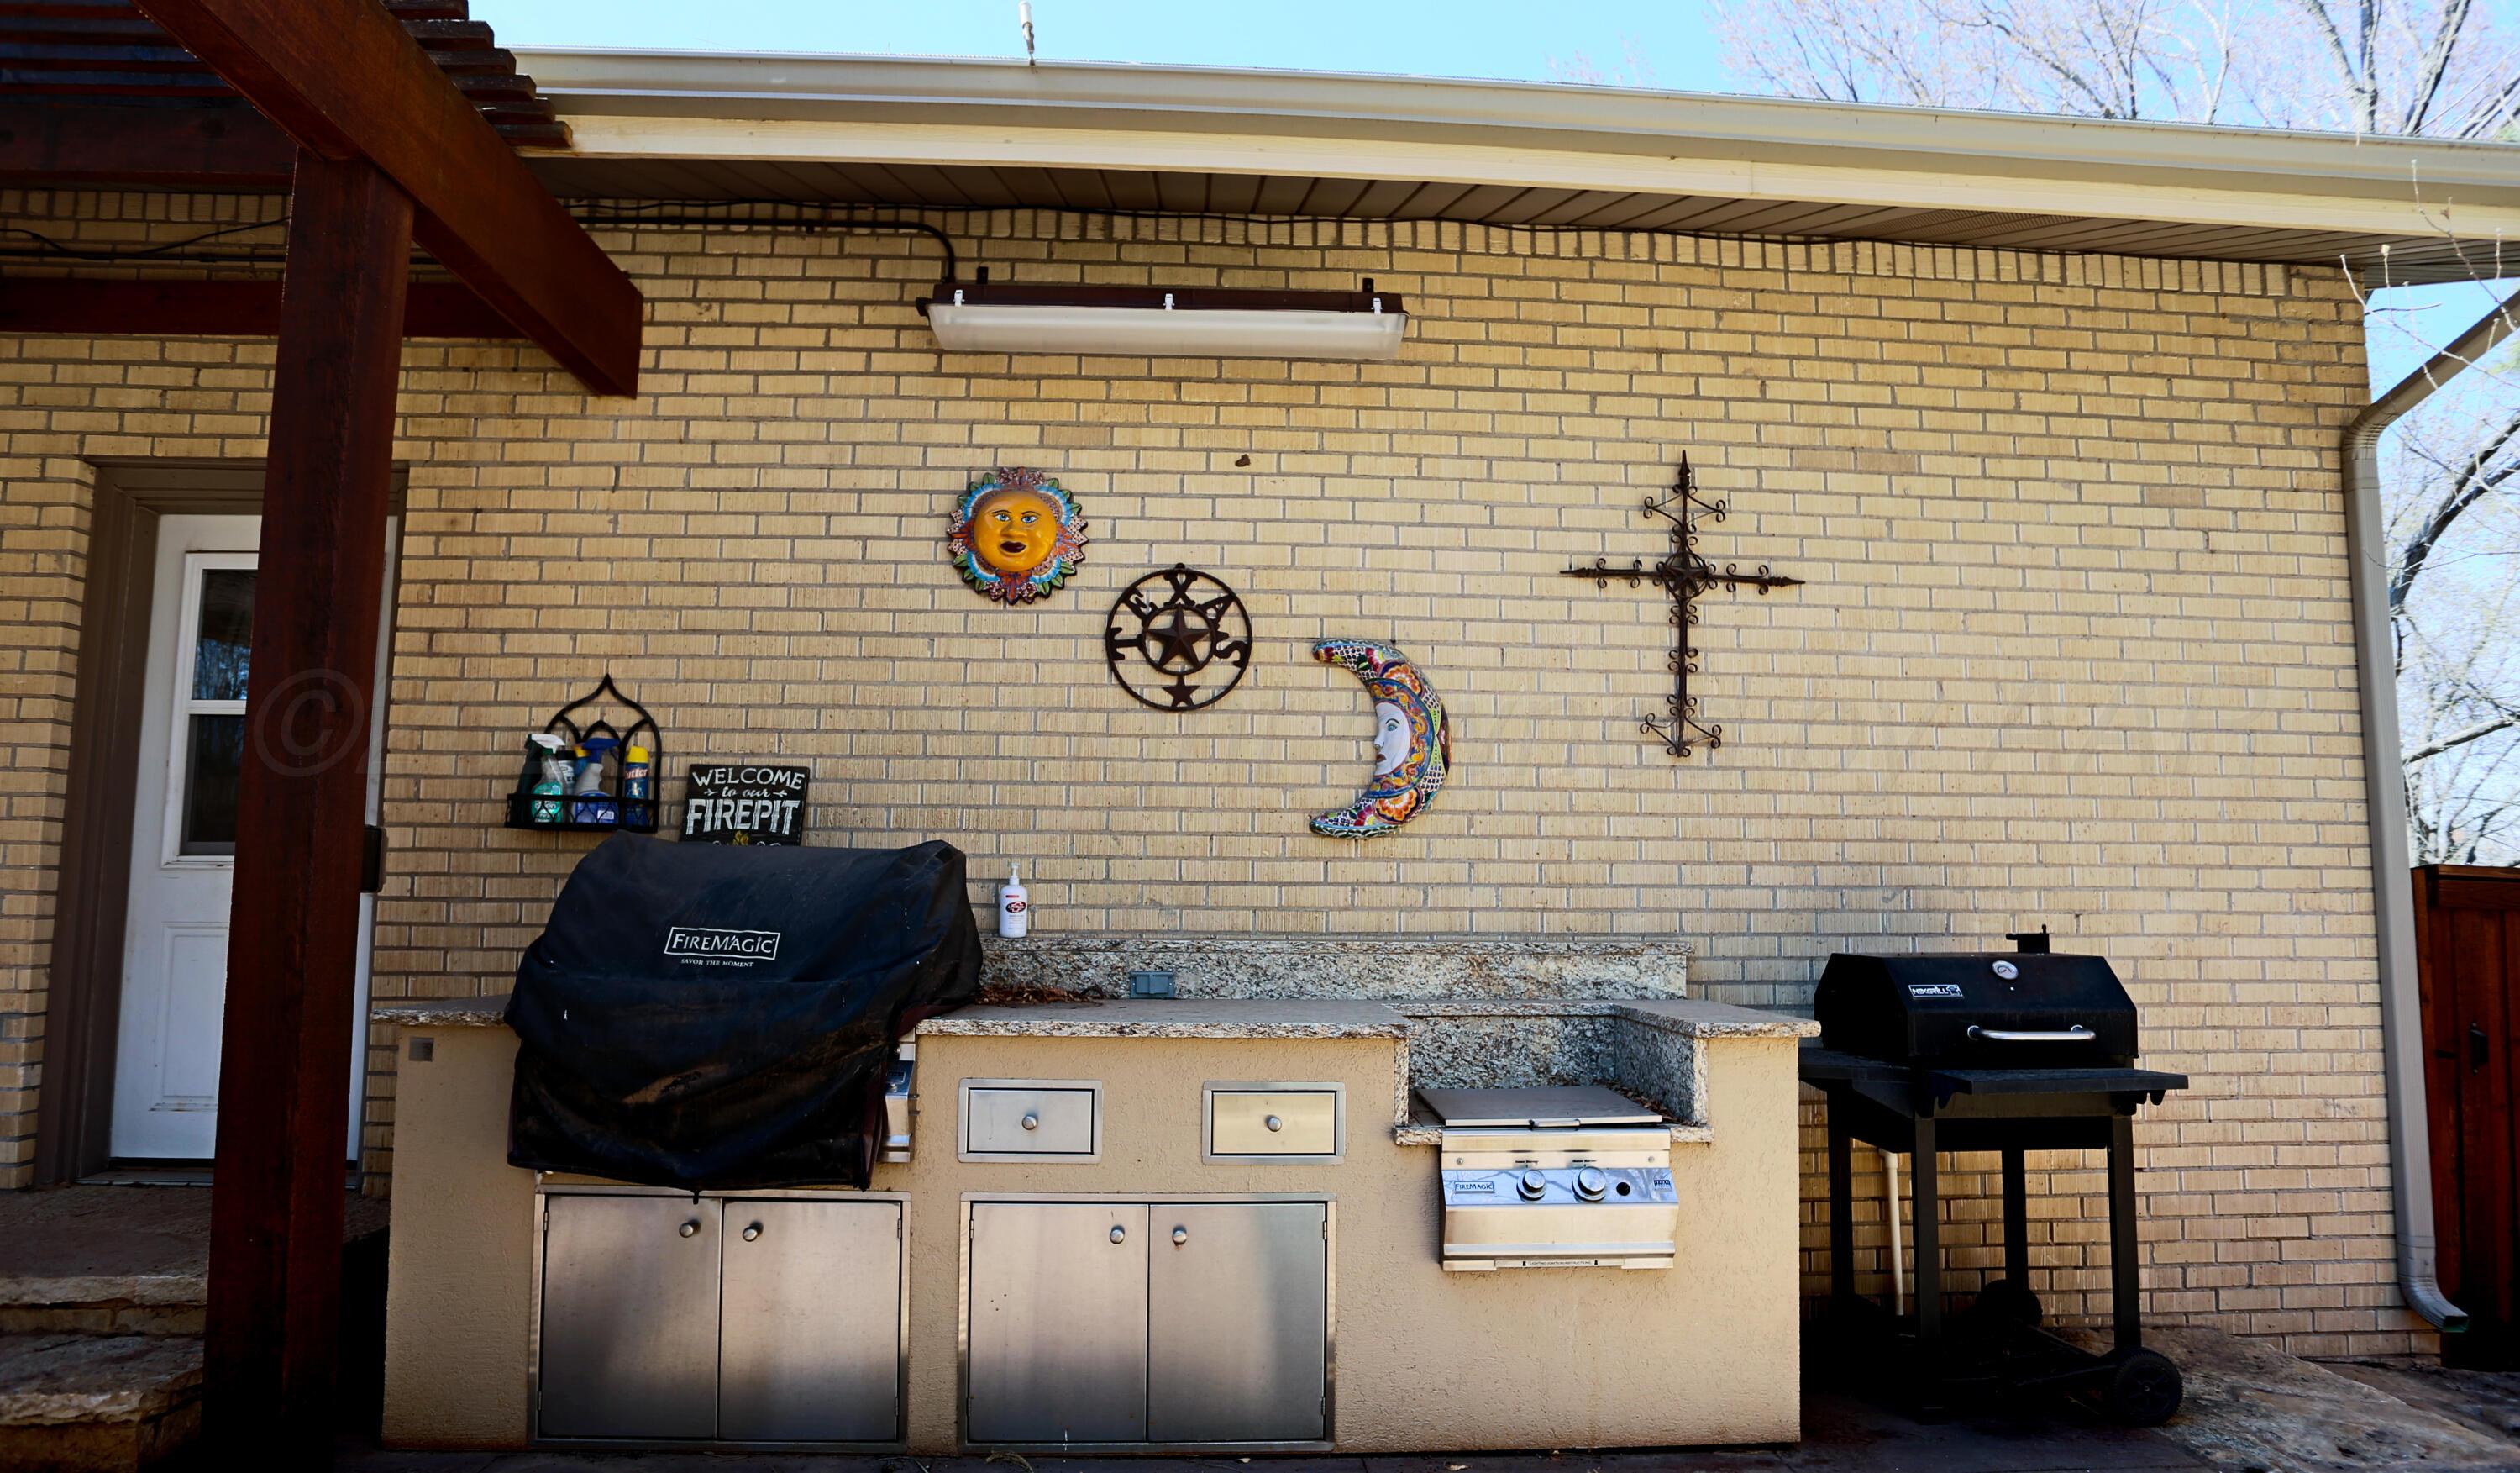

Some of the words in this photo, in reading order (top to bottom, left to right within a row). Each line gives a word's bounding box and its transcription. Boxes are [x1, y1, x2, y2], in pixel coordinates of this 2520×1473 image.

[1109, 571, 1249, 668] TEXAS
[692, 767, 805, 790] WELCOME
[722, 786, 738, 797] to
[742, 788, 772, 797] our
[685, 798, 801, 835] FIREPIT
